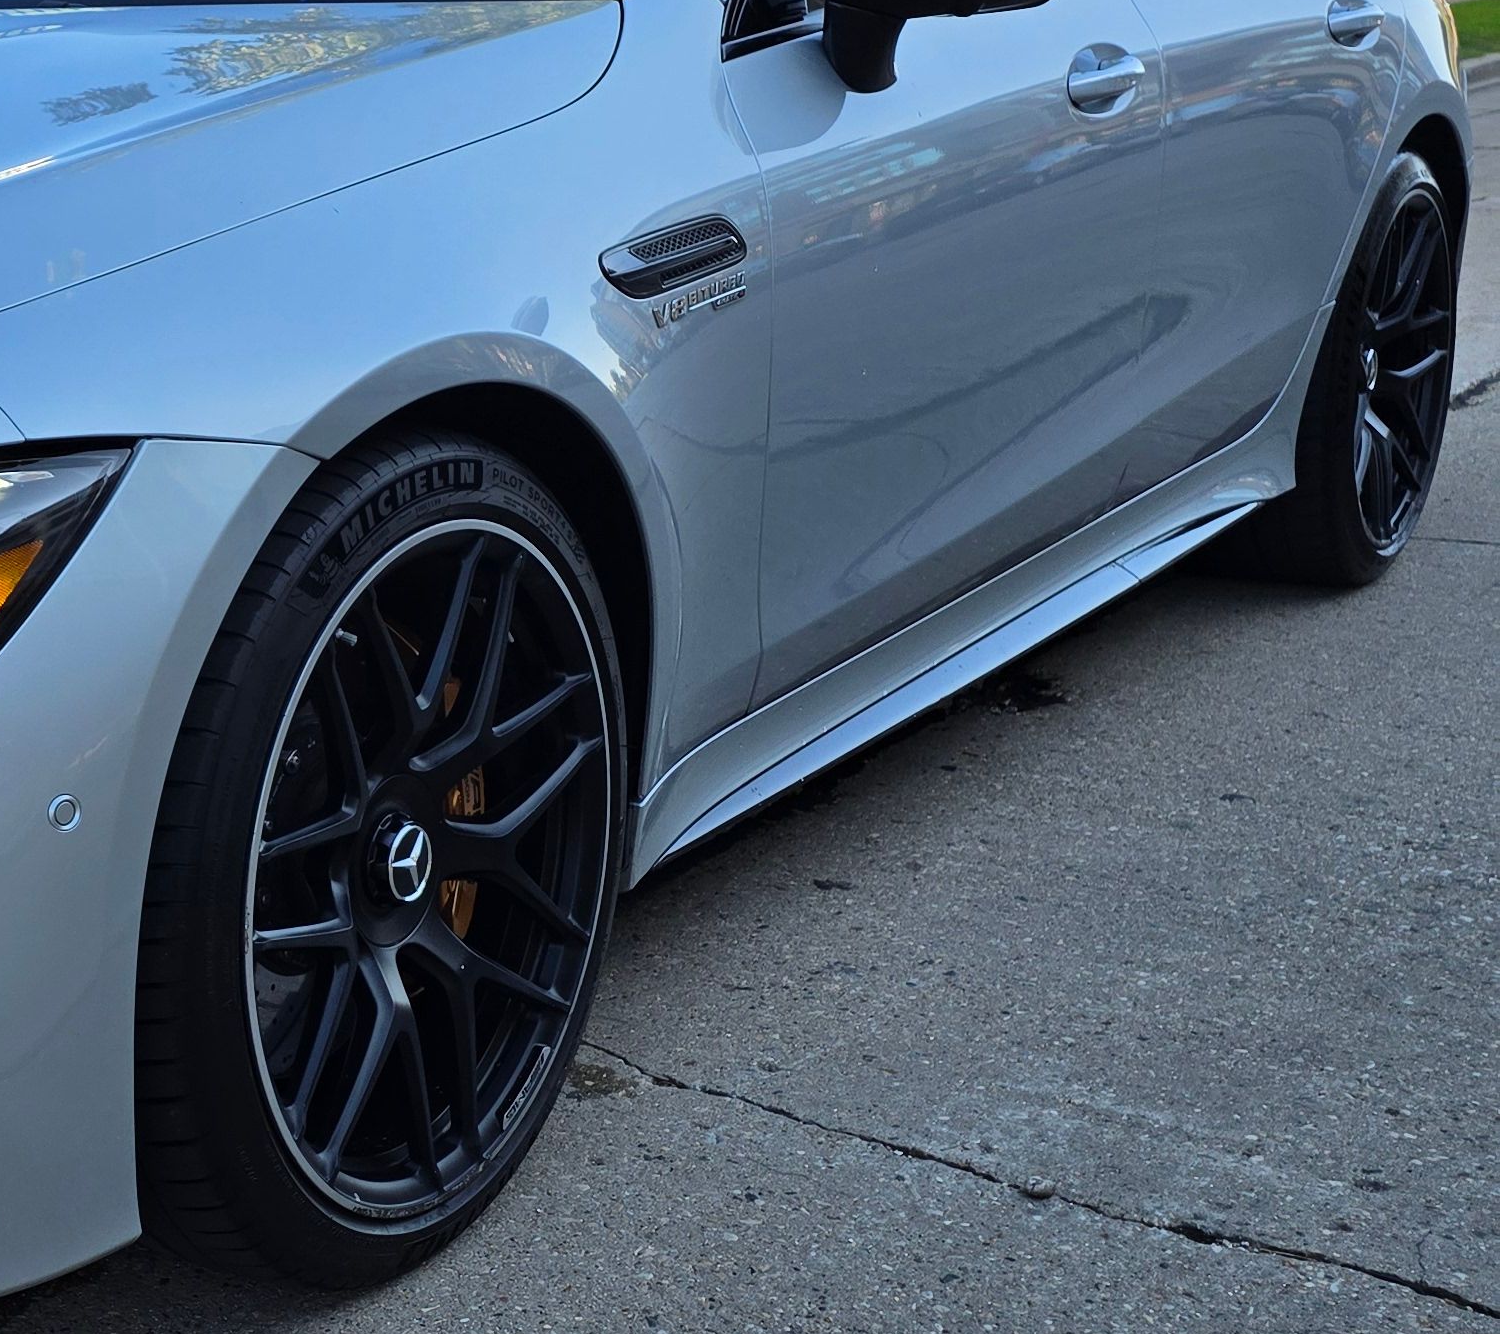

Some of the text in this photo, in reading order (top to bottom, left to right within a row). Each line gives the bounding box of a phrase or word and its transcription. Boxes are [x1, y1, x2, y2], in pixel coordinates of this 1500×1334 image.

[652, 271, 746, 328] V8 BITURBO
[340, 462, 475, 554] MICHELIN
[492, 467, 525, 492] PILOT
[527, 486, 563, 523] SPORT
